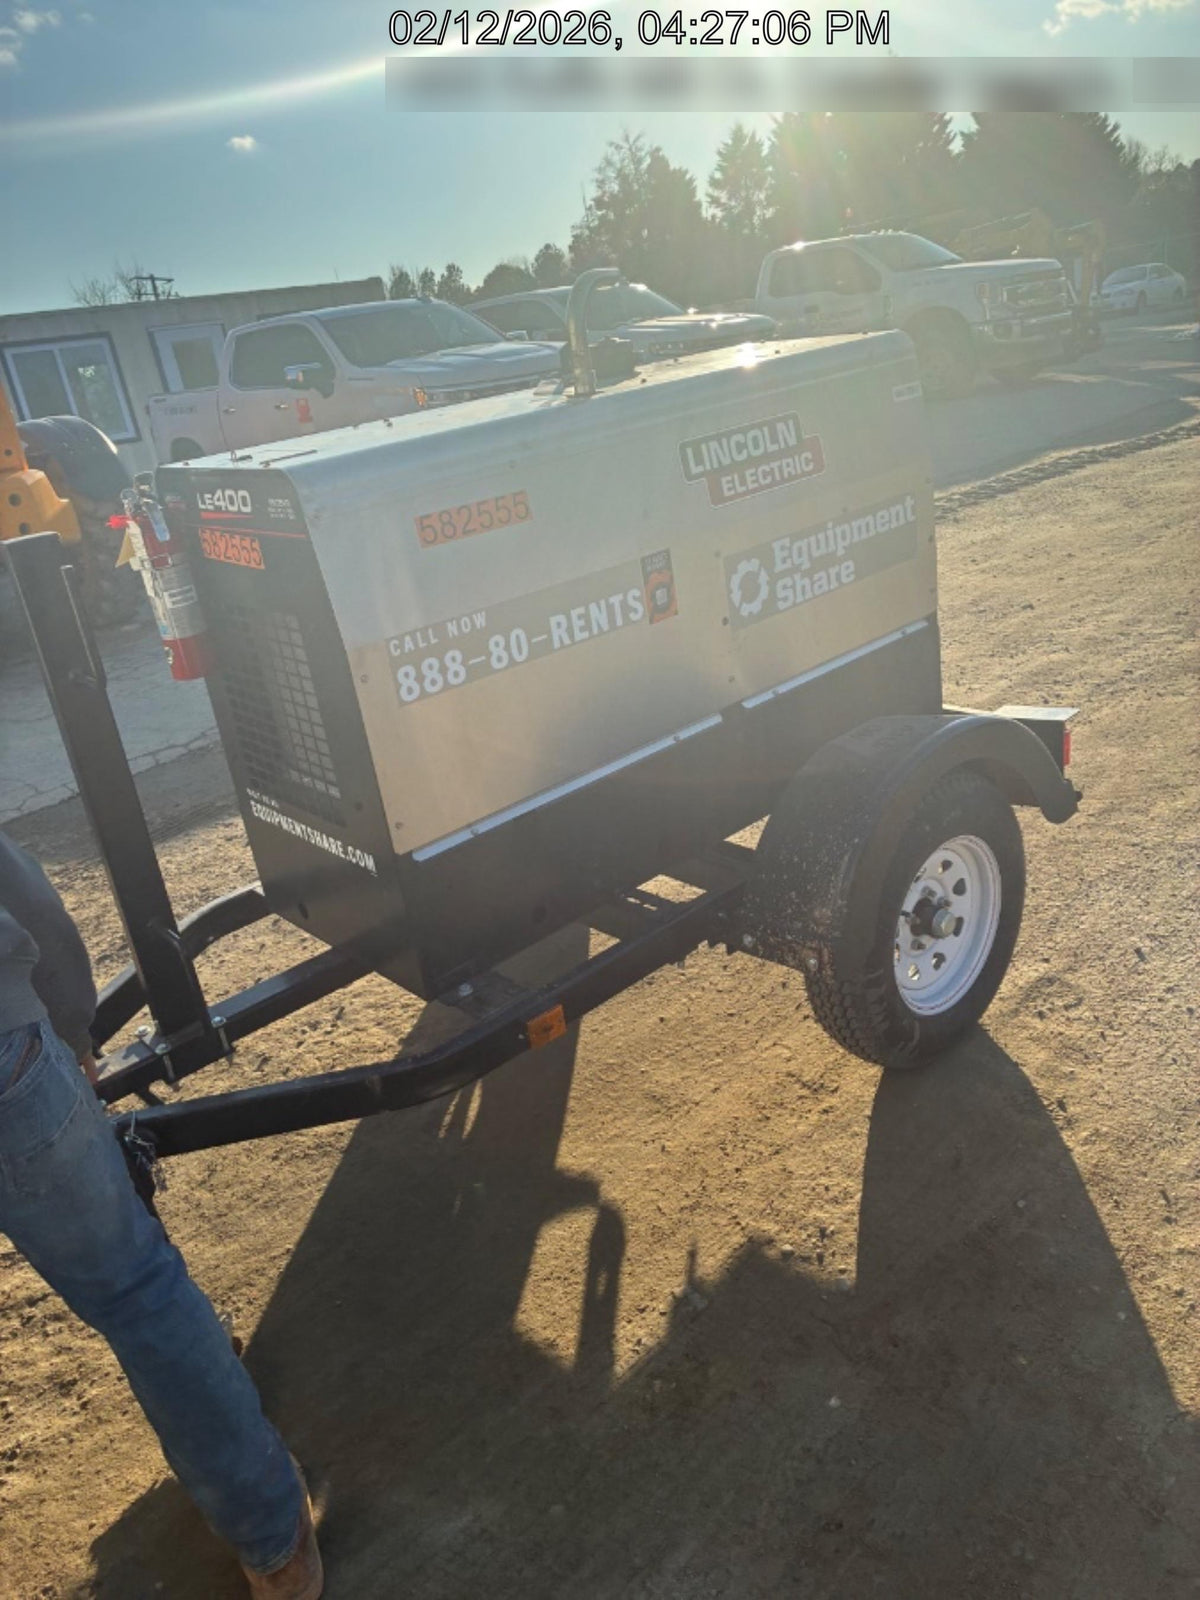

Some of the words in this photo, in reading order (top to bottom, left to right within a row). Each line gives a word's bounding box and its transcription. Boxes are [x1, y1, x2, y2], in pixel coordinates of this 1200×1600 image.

[685, 418, 799, 475] LINCOLN
[196, 487, 252, 513] LE400
[720, 451, 816, 498] ELECTRIC
[417, 491, 531, 547] 582555
[771, 495, 917, 573] Equipment
[200, 527, 263, 567] 582555
[775, 559, 856, 611] Share
[388, 627, 439, 657] CALL
[446, 610, 487, 638] NOW
[396, 587, 645, 703] 888-80-RENTS
[249, 798, 377, 873] EQUIPMENTSHARE.COM
